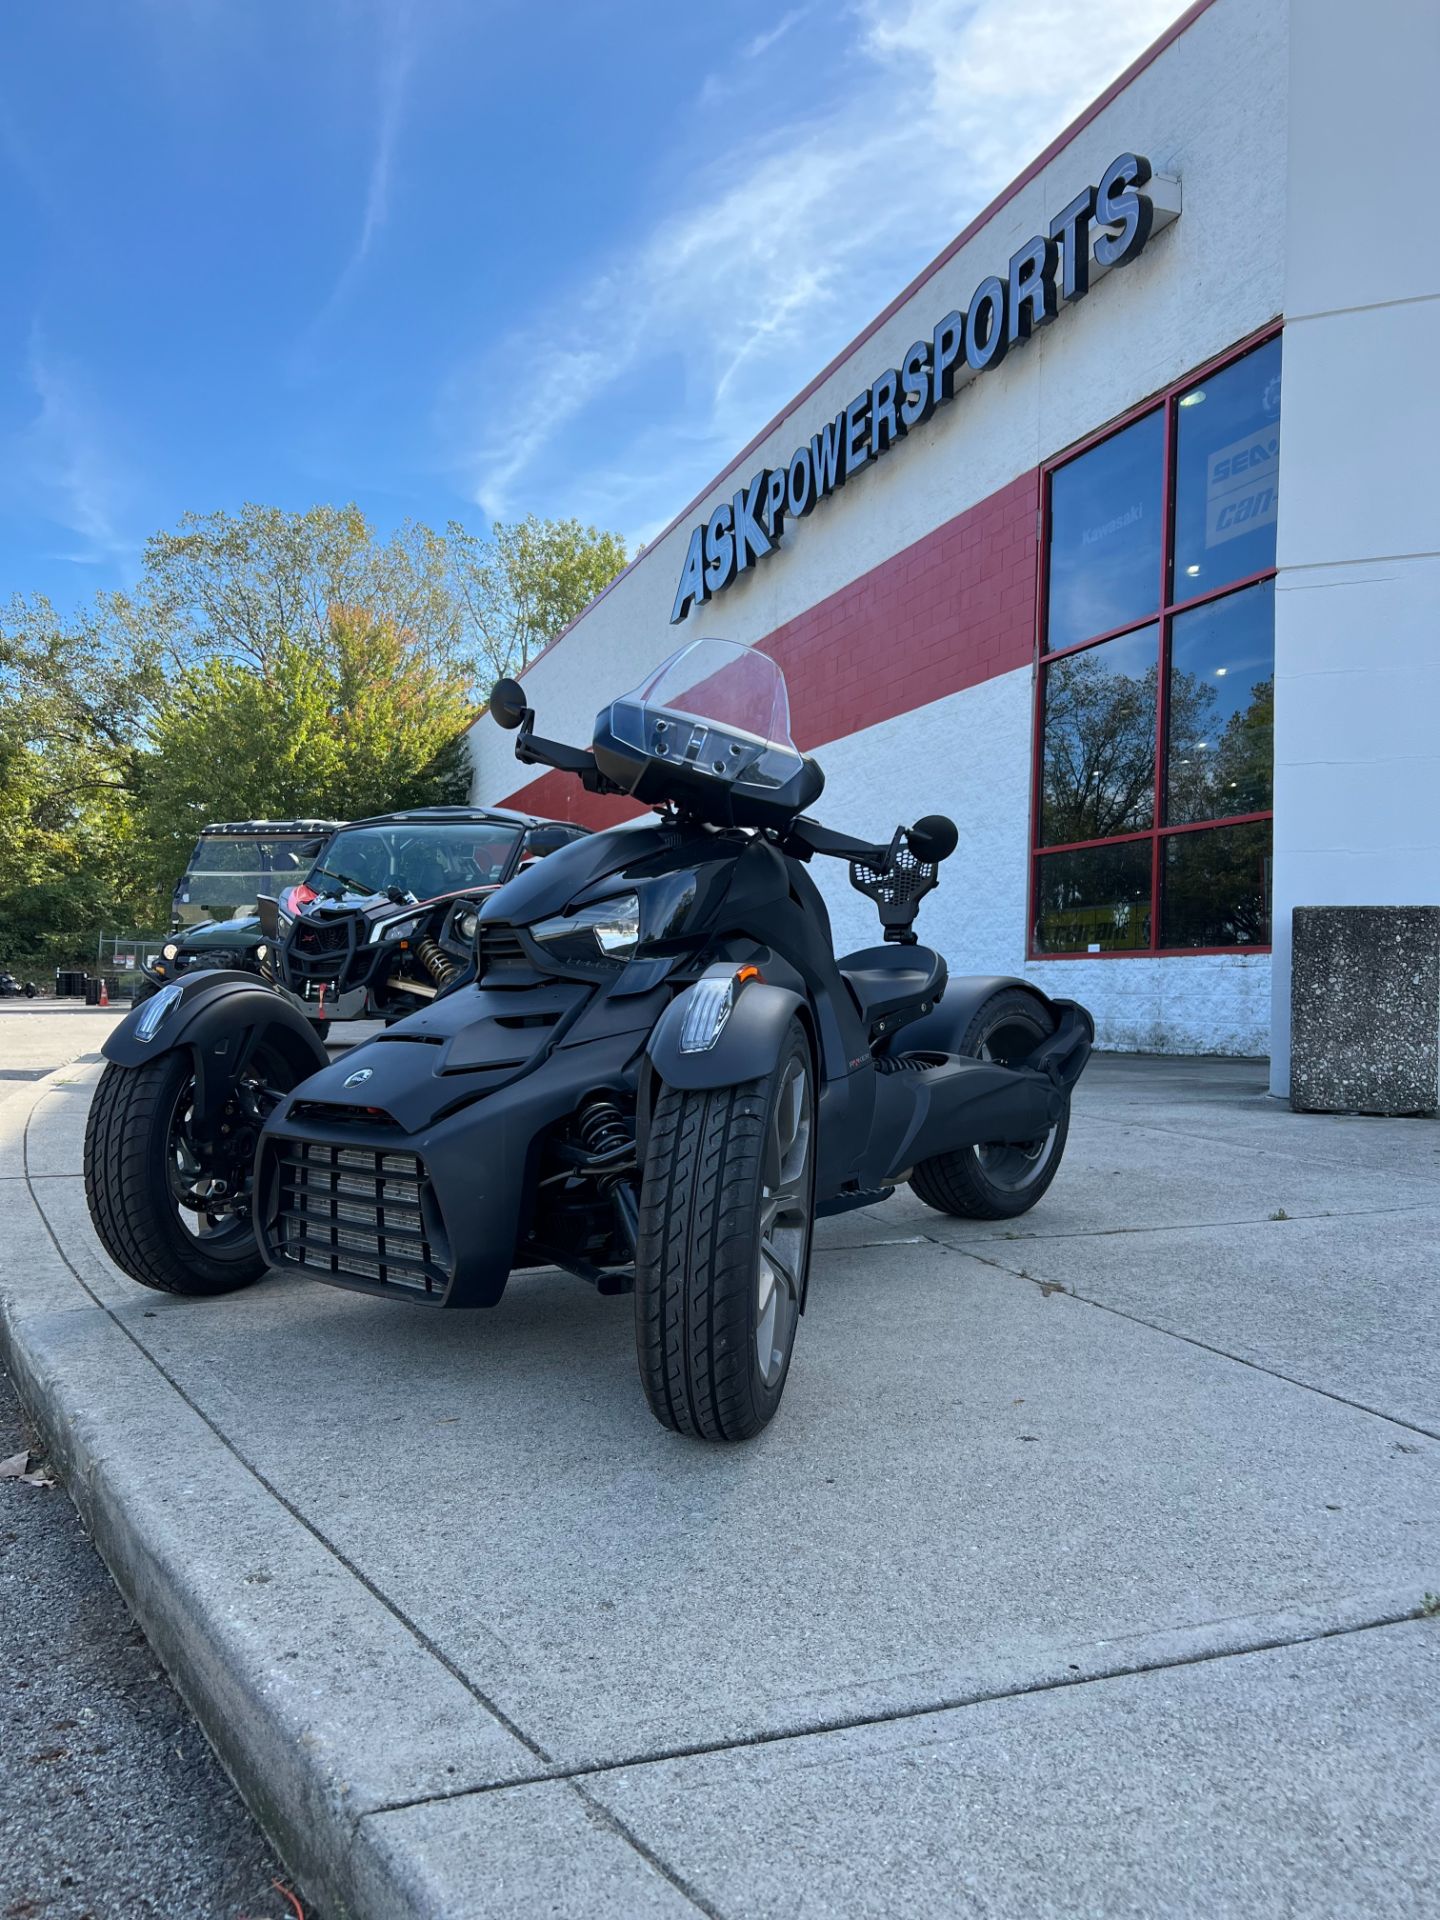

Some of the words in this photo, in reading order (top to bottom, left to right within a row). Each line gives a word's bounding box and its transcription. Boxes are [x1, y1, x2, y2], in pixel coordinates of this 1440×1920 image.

[670, 469, 780, 624] ASK
[767, 152, 1154, 539] POWERSPORTS
[1082, 501, 1144, 546] Kawasaki
